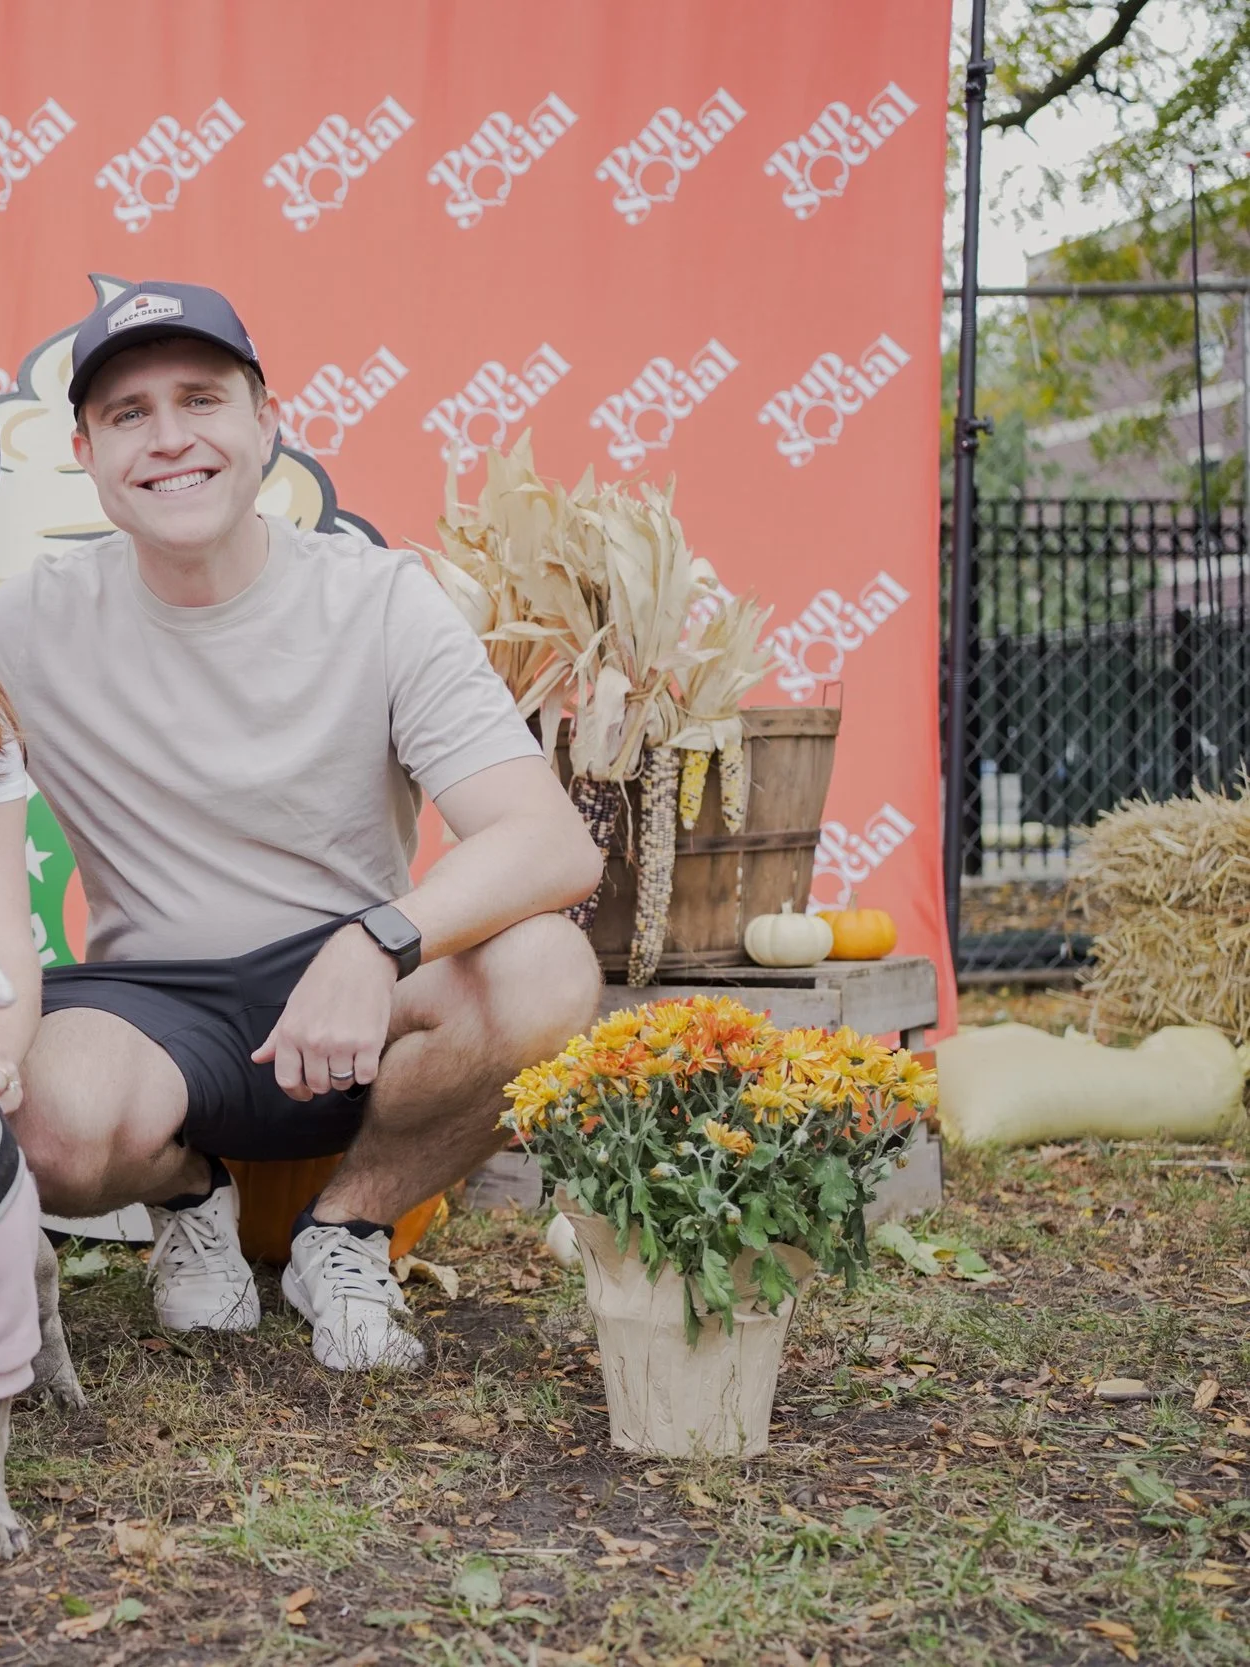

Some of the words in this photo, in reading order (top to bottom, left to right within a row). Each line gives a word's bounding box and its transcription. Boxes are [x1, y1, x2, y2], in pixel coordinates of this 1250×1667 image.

[94, 115, 181, 195] Pup
[112, 96, 245, 234] Social
[263, 114, 350, 193] Pup
[280, 94, 415, 233] Social
[427, 111, 514, 190] Pup
[444, 91, 579, 229] Social
[594, 106, 682, 185] Pup
[611, 86, 747, 225] Social
[763, 100, 853, 180] Pup
[780, 80, 919, 220] Social
[114, 313, 139, 328] BLACK
[141, 308, 174, 316] DESERT
[589, 357, 675, 433] Pup
[606, 337, 739, 472] Social
[757, 352, 845, 429] Pup
[774, 332, 911, 468] Social
[777, 570, 910, 701] Social
[806, 803, 916, 916] ocial
